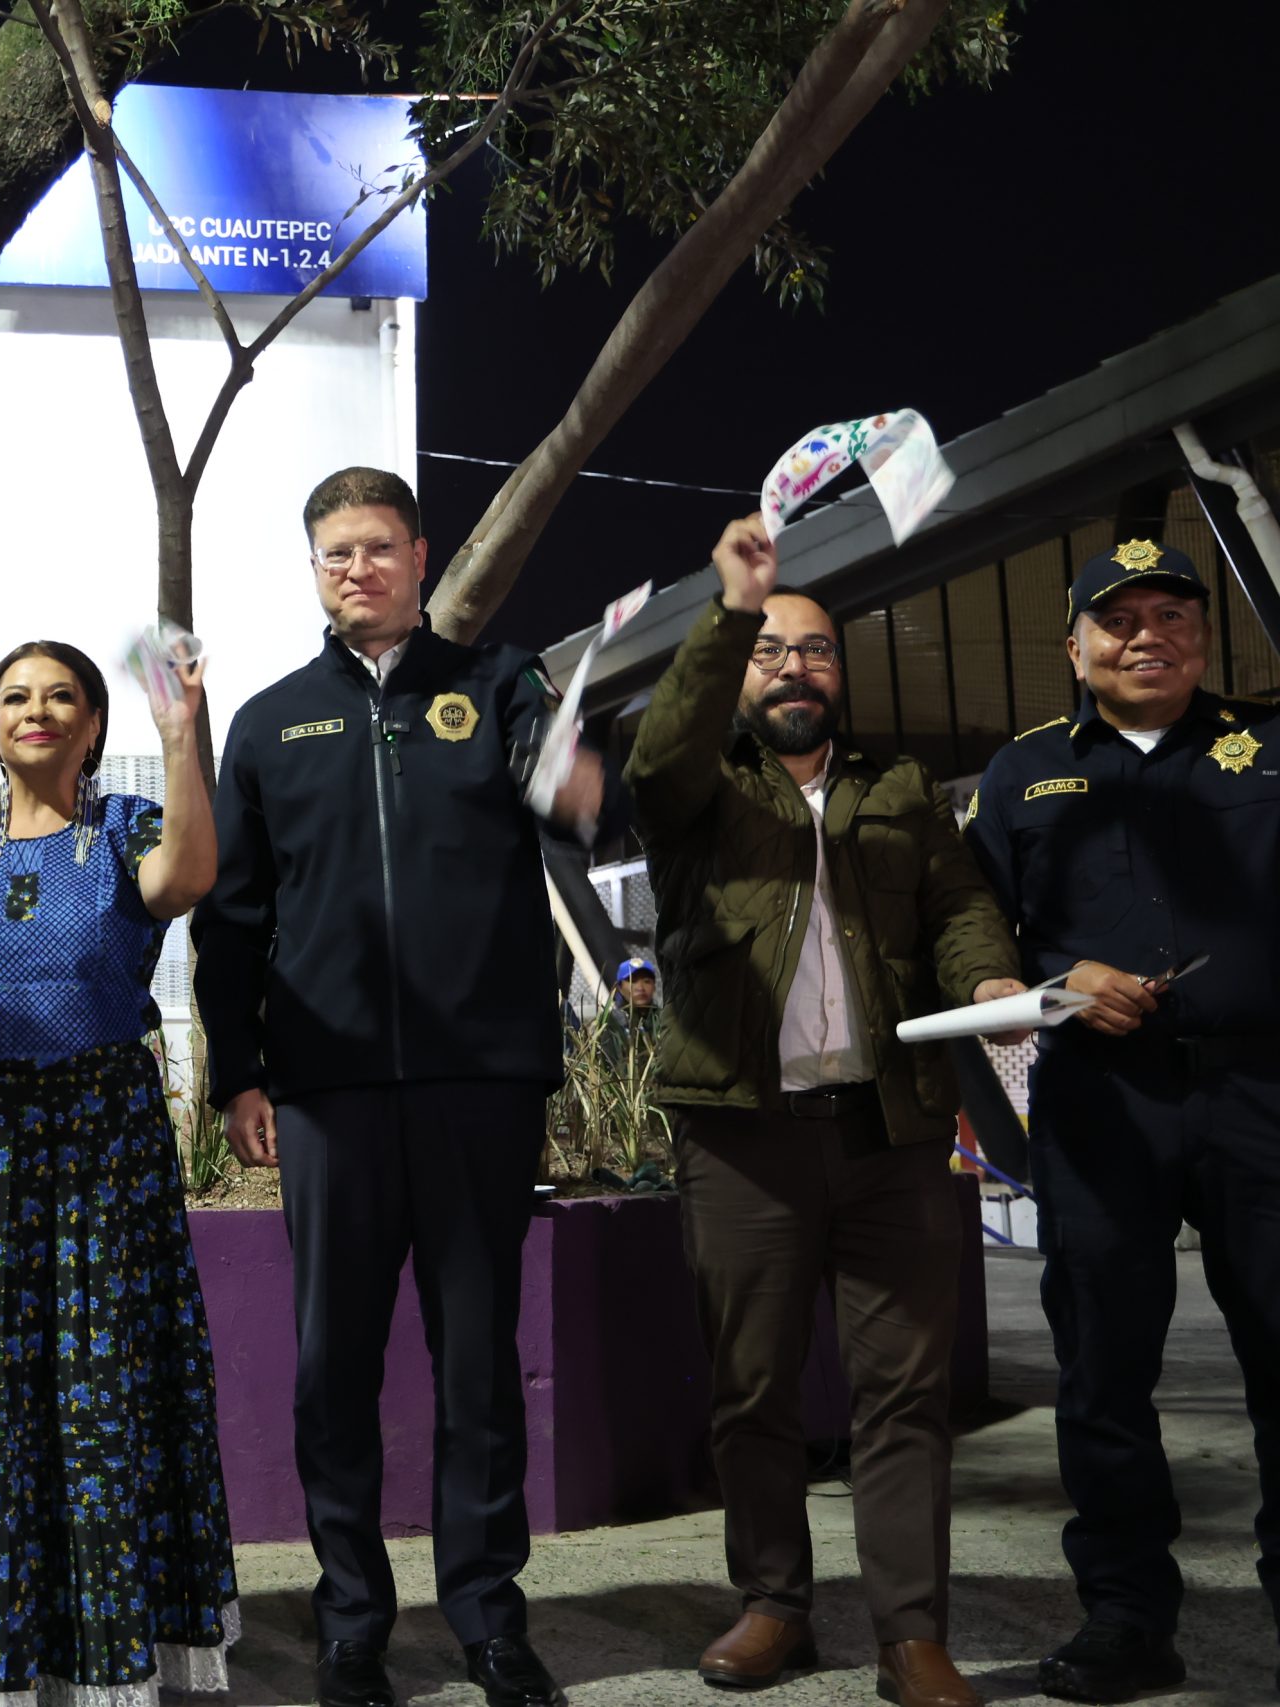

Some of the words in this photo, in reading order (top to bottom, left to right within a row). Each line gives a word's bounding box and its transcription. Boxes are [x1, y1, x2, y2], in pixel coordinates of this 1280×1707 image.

[199, 217, 332, 242] CUAUTEPEC
[132, 242, 248, 267] UADANTE
[252, 247, 332, 270] N-1.2.4
[291, 724, 333, 736] TAURO
[1033, 781, 1077, 795] ALAMO
